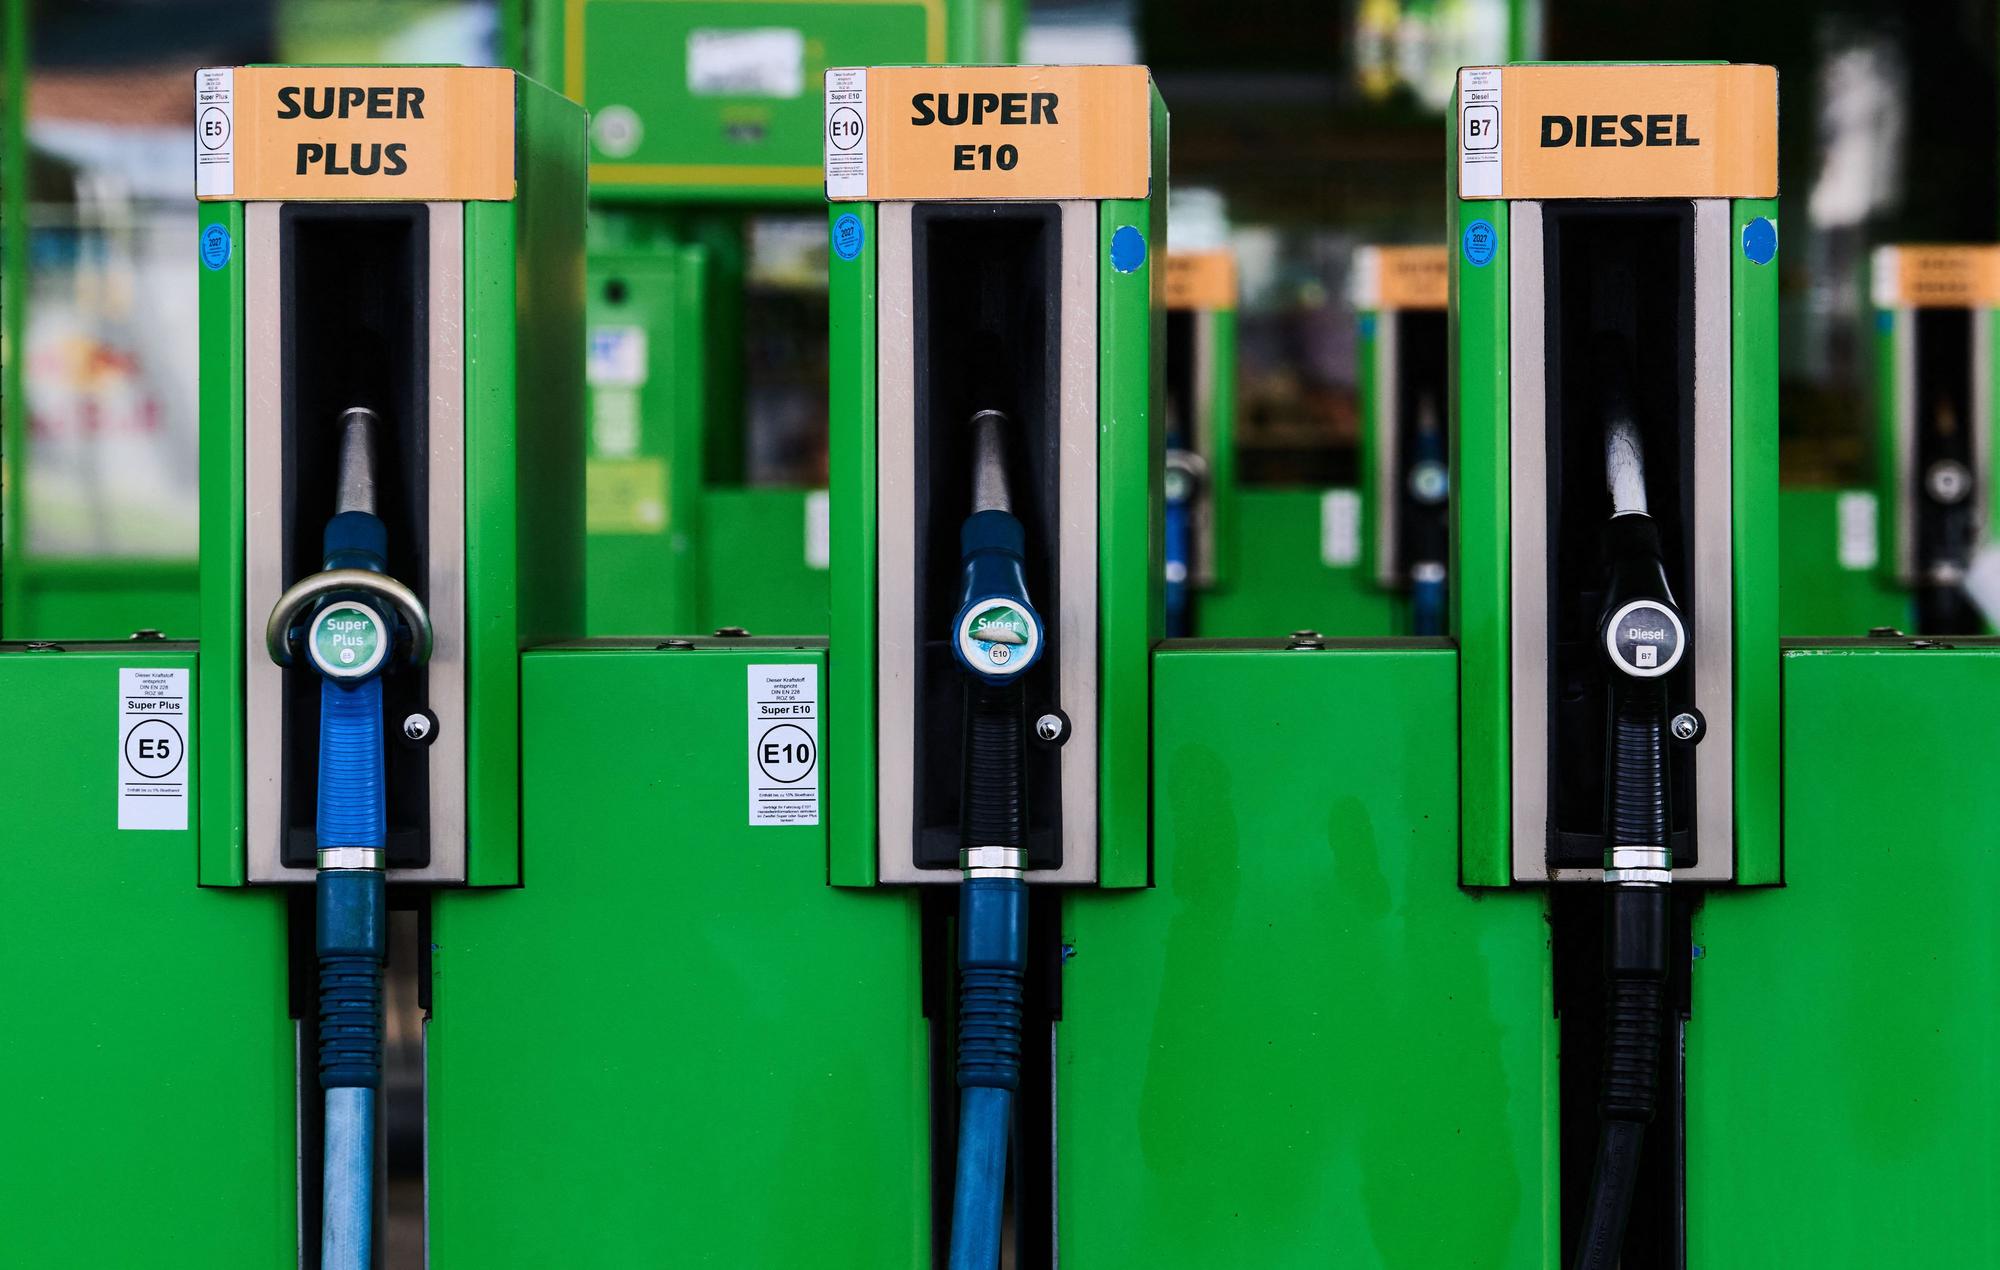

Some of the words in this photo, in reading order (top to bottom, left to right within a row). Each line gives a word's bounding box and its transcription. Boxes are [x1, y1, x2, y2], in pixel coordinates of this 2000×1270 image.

[277, 86, 425, 119] SUPER
[831, 93, 847, 101] Super
[911, 92, 1059, 126] SUPER
[205, 121, 222, 136] E5
[832, 121, 859, 136] E10
[1470, 119, 1491, 137] B7
[1540, 114, 1700, 148] DIESEL
[296, 143, 408, 176] PLUS
[953, 144, 1019, 171] E10
[1472, 233, 1488, 243] 2027
[327, 618, 369, 633] Super
[332, 634, 364, 646] Plus
[1629, 628, 1664, 640] Diesel
[992, 650, 1008, 658] E10
[1641, 652, 1652, 660] B7
[128, 700, 156, 711] Super
[159, 701, 180, 709] Plus
[761, 705, 790, 715] Super
[792, 705, 811, 714] E10
[139, 738, 170, 759] E5
[764, 743, 809, 764] E10
